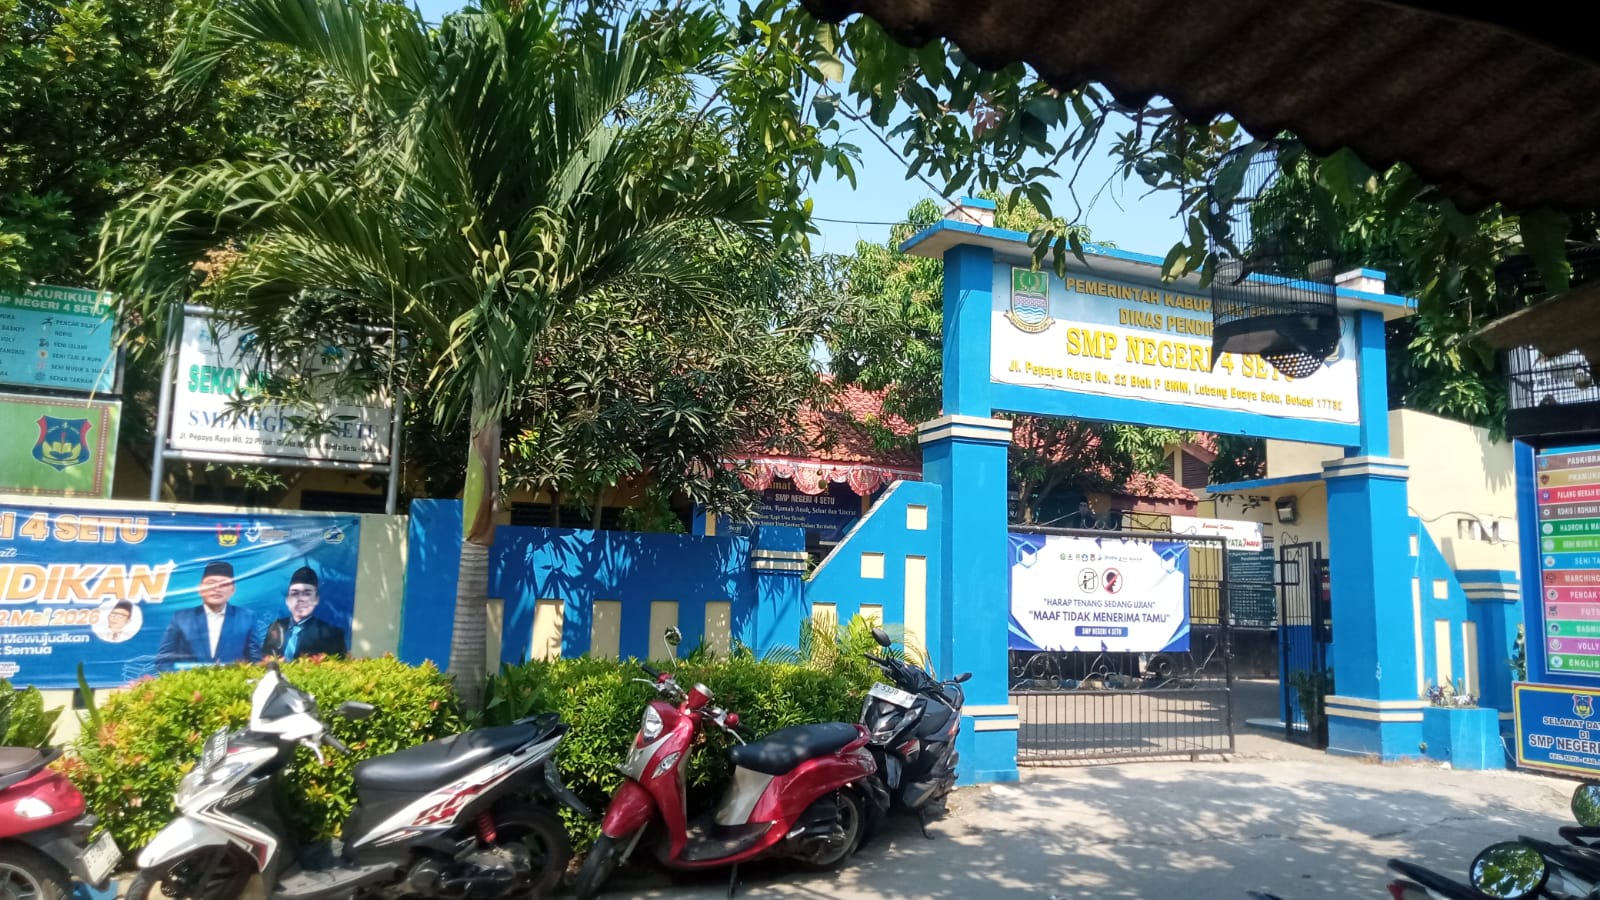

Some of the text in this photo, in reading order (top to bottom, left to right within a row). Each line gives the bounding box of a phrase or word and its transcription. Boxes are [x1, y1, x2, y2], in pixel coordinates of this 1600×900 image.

[1065, 277, 1160, 305] PEMERINTAH
[15, 297, 59, 310] NEGERI
[62, 303, 71, 312] 4
[73, 304, 105, 316] SETU
[1119, 307, 1214, 337] DINAS PENDI
[1066, 327, 1118, 360] SMP
[1066, 367, 1092, 384] Raya
[1095, 372, 1111, 385] No.
[1130, 376, 1151, 390] Blok
[1194, 384, 1228, 400] Lubang
[1285, 393, 1314, 408] Bekasi
[188, 409, 230, 429] SMP
[775, 493, 790, 502] SMP
[790, 494, 813, 503] NEGERI
[819, 496, 836, 505] SETU
[1557, 490, 1576, 499] PALANG
[1577, 489, 1595, 497] MERAH
[20, 512, 50, 541] 4
[53, 514, 149, 544] SETU
[1575, 557, 1592, 565] SENI
[1570, 591, 1598, 599] PENCAK
[1073, 599, 1103, 608] TENANG
[1104, 600, 1133, 609] SEDANG
[51, 609, 100, 626] 2026
[1062, 611, 1091, 622] TIDAK
[1092, 612, 1140, 623] MENERIMA
[4, 633, 90, 645] Mewujudkan
[4, 646, 53, 655] Semua
[1578, 642, 1599, 650] VOLLY
[1543, 716, 1585, 728] SELAMAT
[1579, 730, 1590, 740] DI
[1529, 734, 1554, 749] SMP
